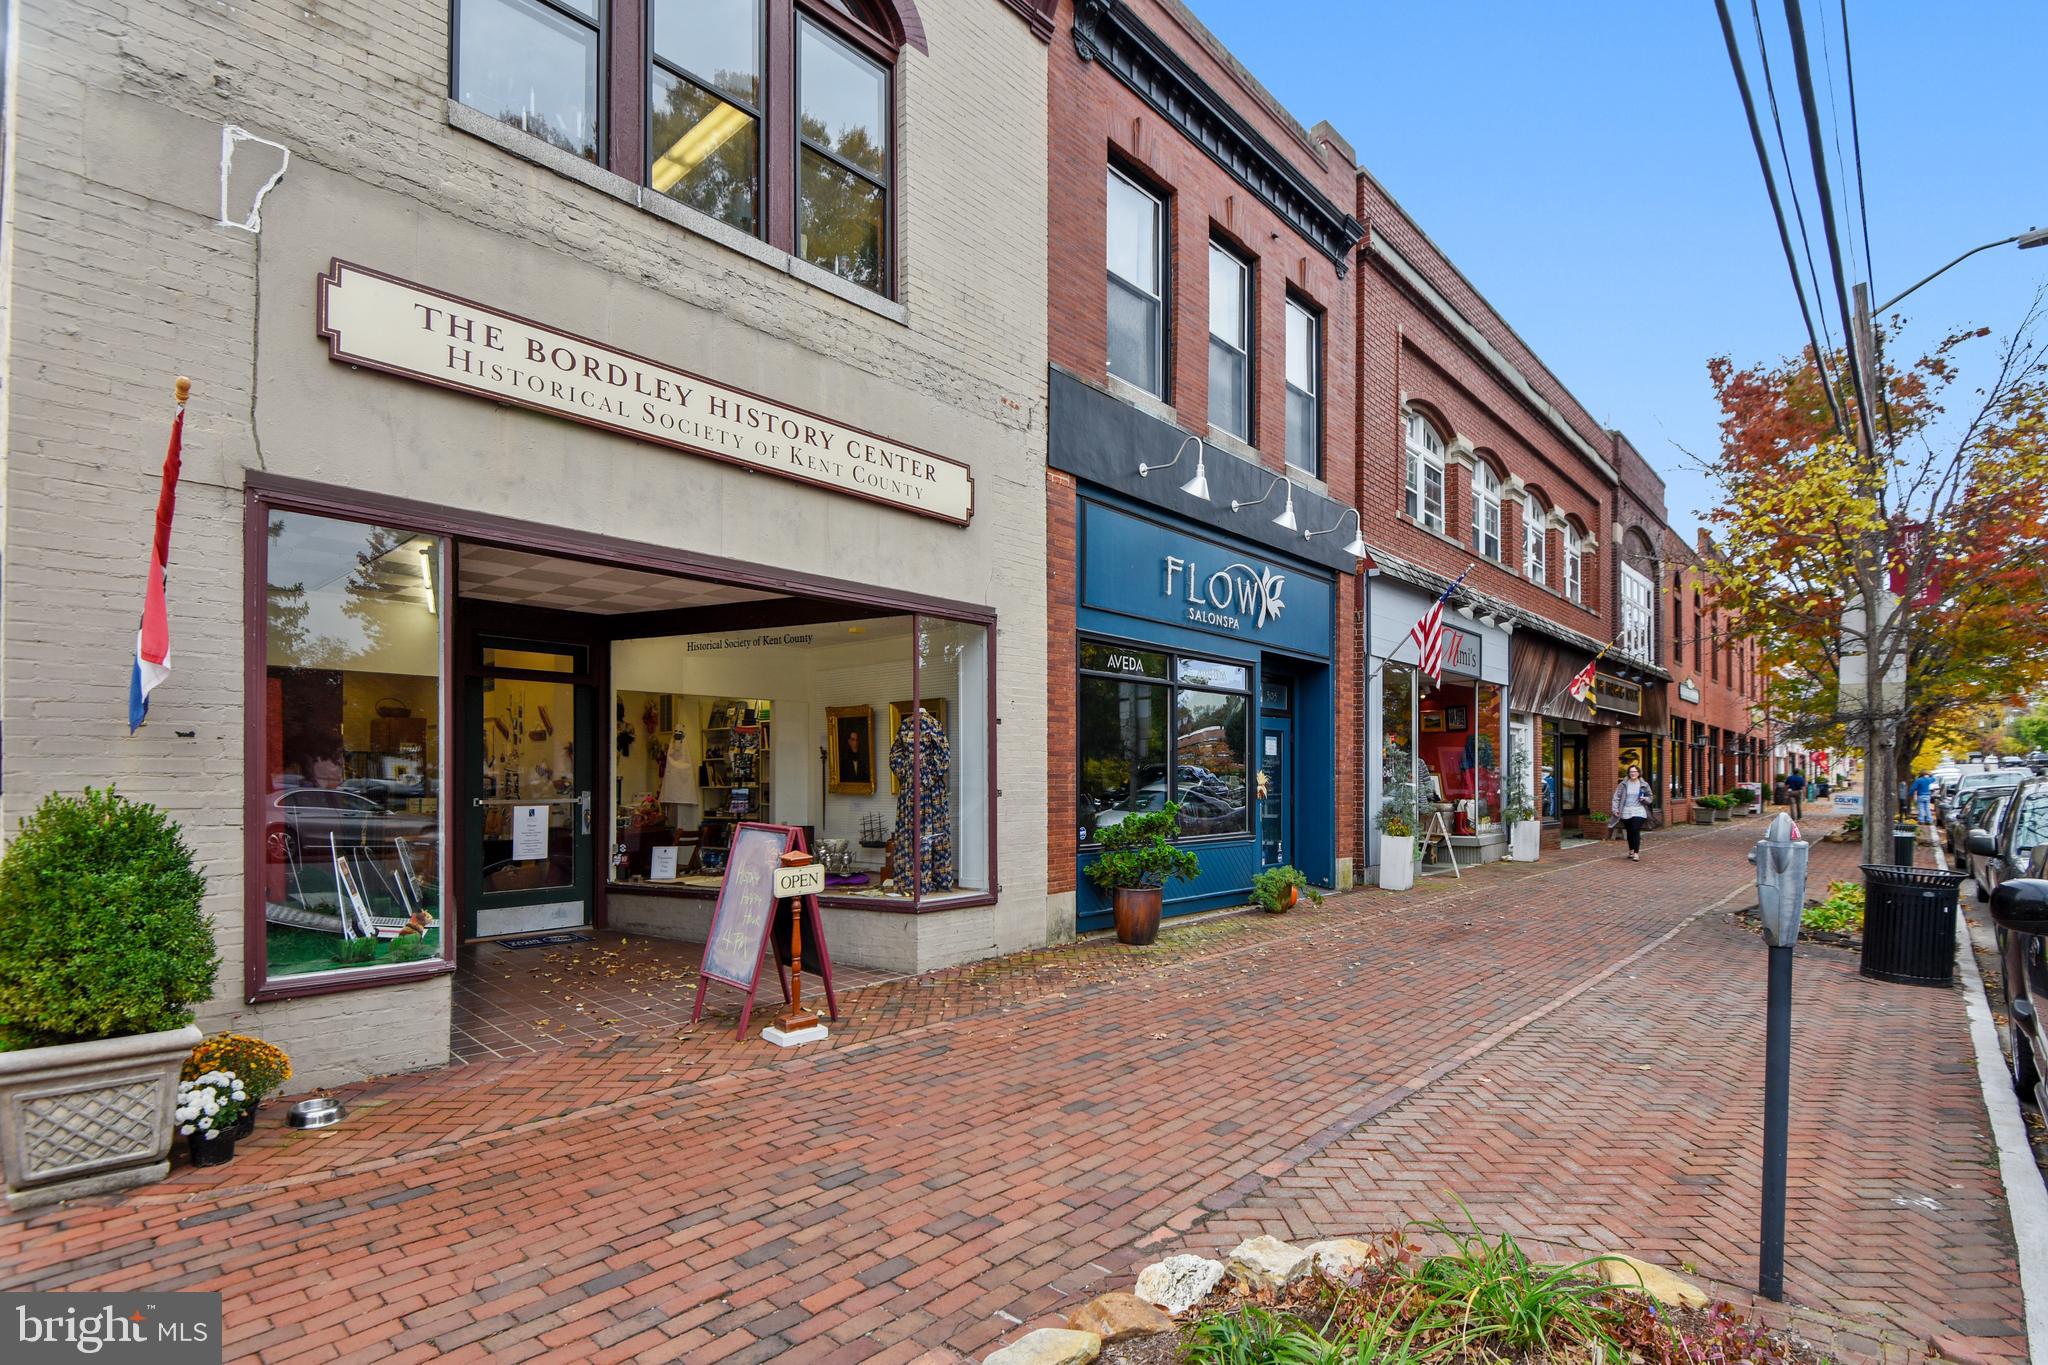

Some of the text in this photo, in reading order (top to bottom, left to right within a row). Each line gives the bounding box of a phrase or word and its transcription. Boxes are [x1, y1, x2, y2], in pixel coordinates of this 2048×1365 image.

[414, 303, 937, 482] THE BORDLEY HISTORY CENTER
[447, 344, 630, 418] HISTORICAL
[642, 402, 744, 449] SOCIETY
[790, 445, 844, 477] KENT
[852, 465, 923, 499] COUNTY
[1165, 555, 1258, 616] FLOW
[1188, 607, 1240, 630] SALONSPA
[687, 633, 814, 651] Historical Society of Kent County
[1107, 654, 1144, 672] AVEDA
[781, 872, 819, 890] OPEN
